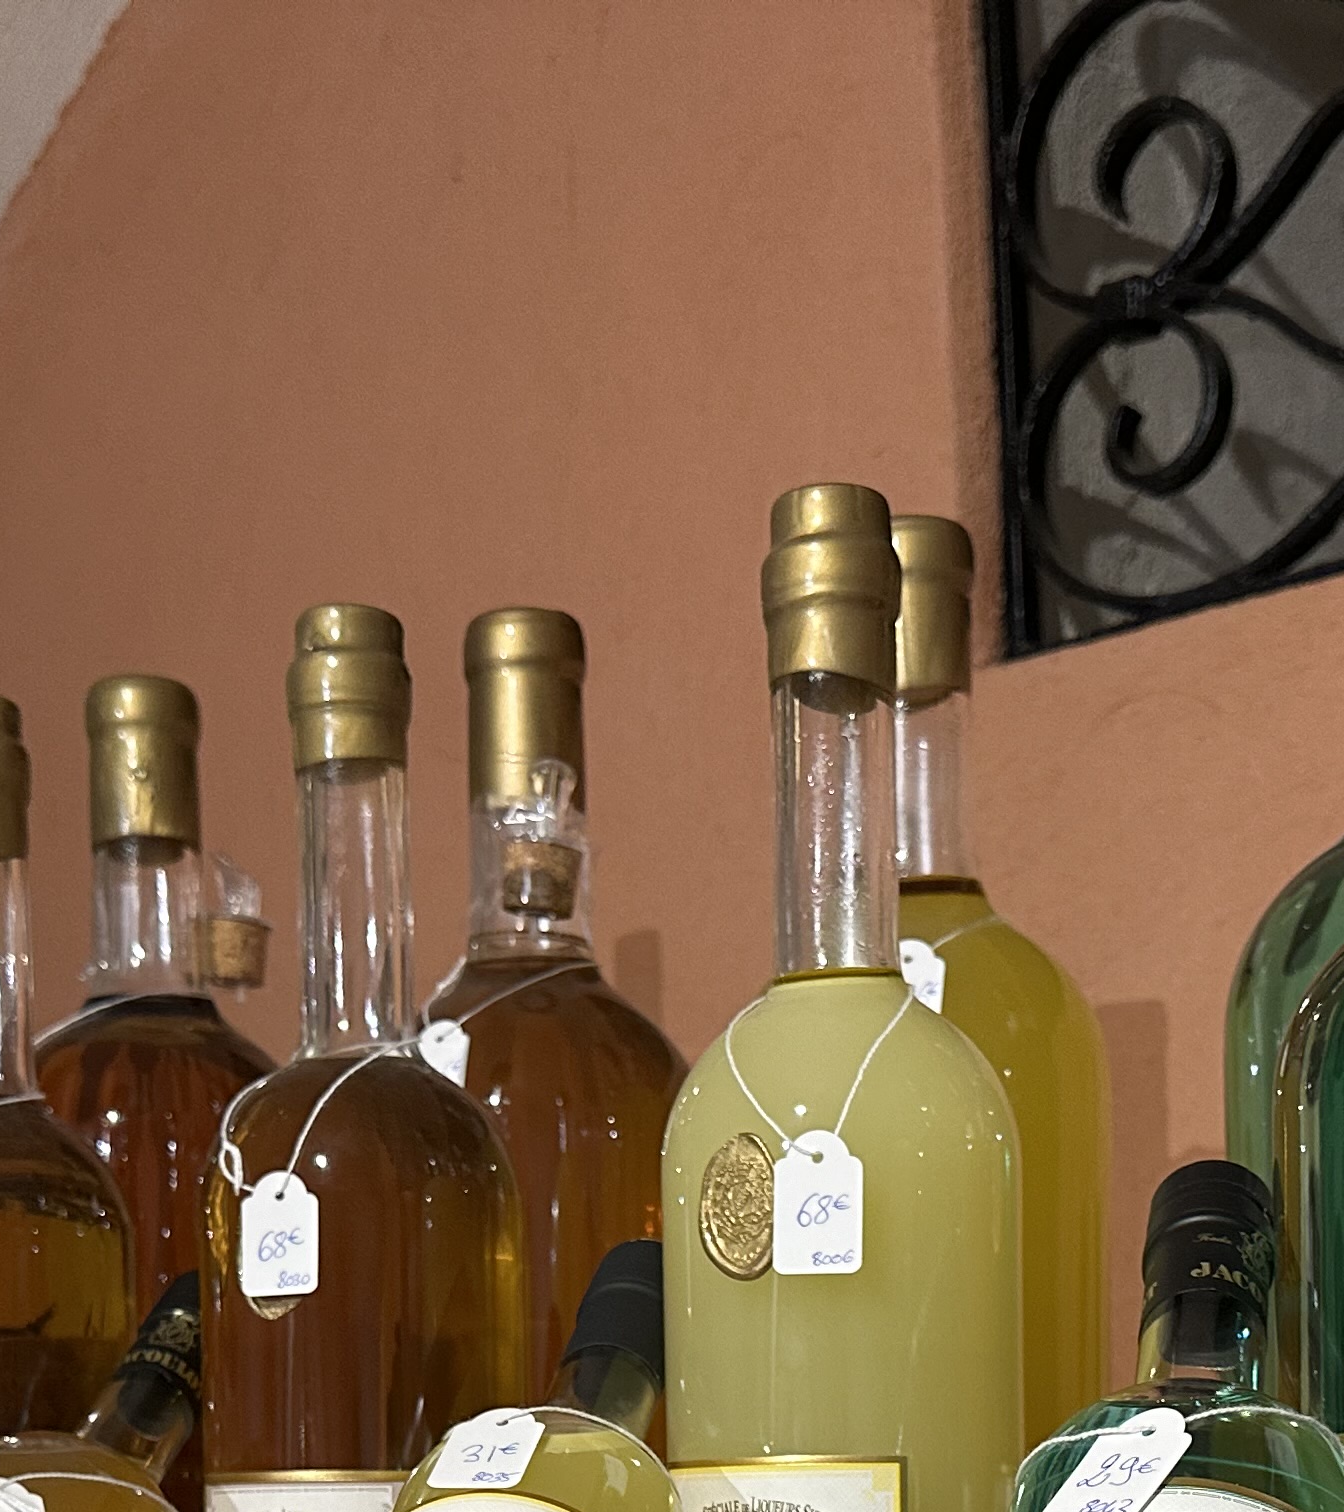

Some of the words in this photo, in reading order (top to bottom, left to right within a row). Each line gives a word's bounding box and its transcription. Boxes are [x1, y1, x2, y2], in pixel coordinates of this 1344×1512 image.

[796, 1193, 852, 1228] 68€
[258, 1228, 304, 1262] 68€
[461, 1442, 520, 1463] 31€
[1076, 1453, 1162, 1487] 29€
